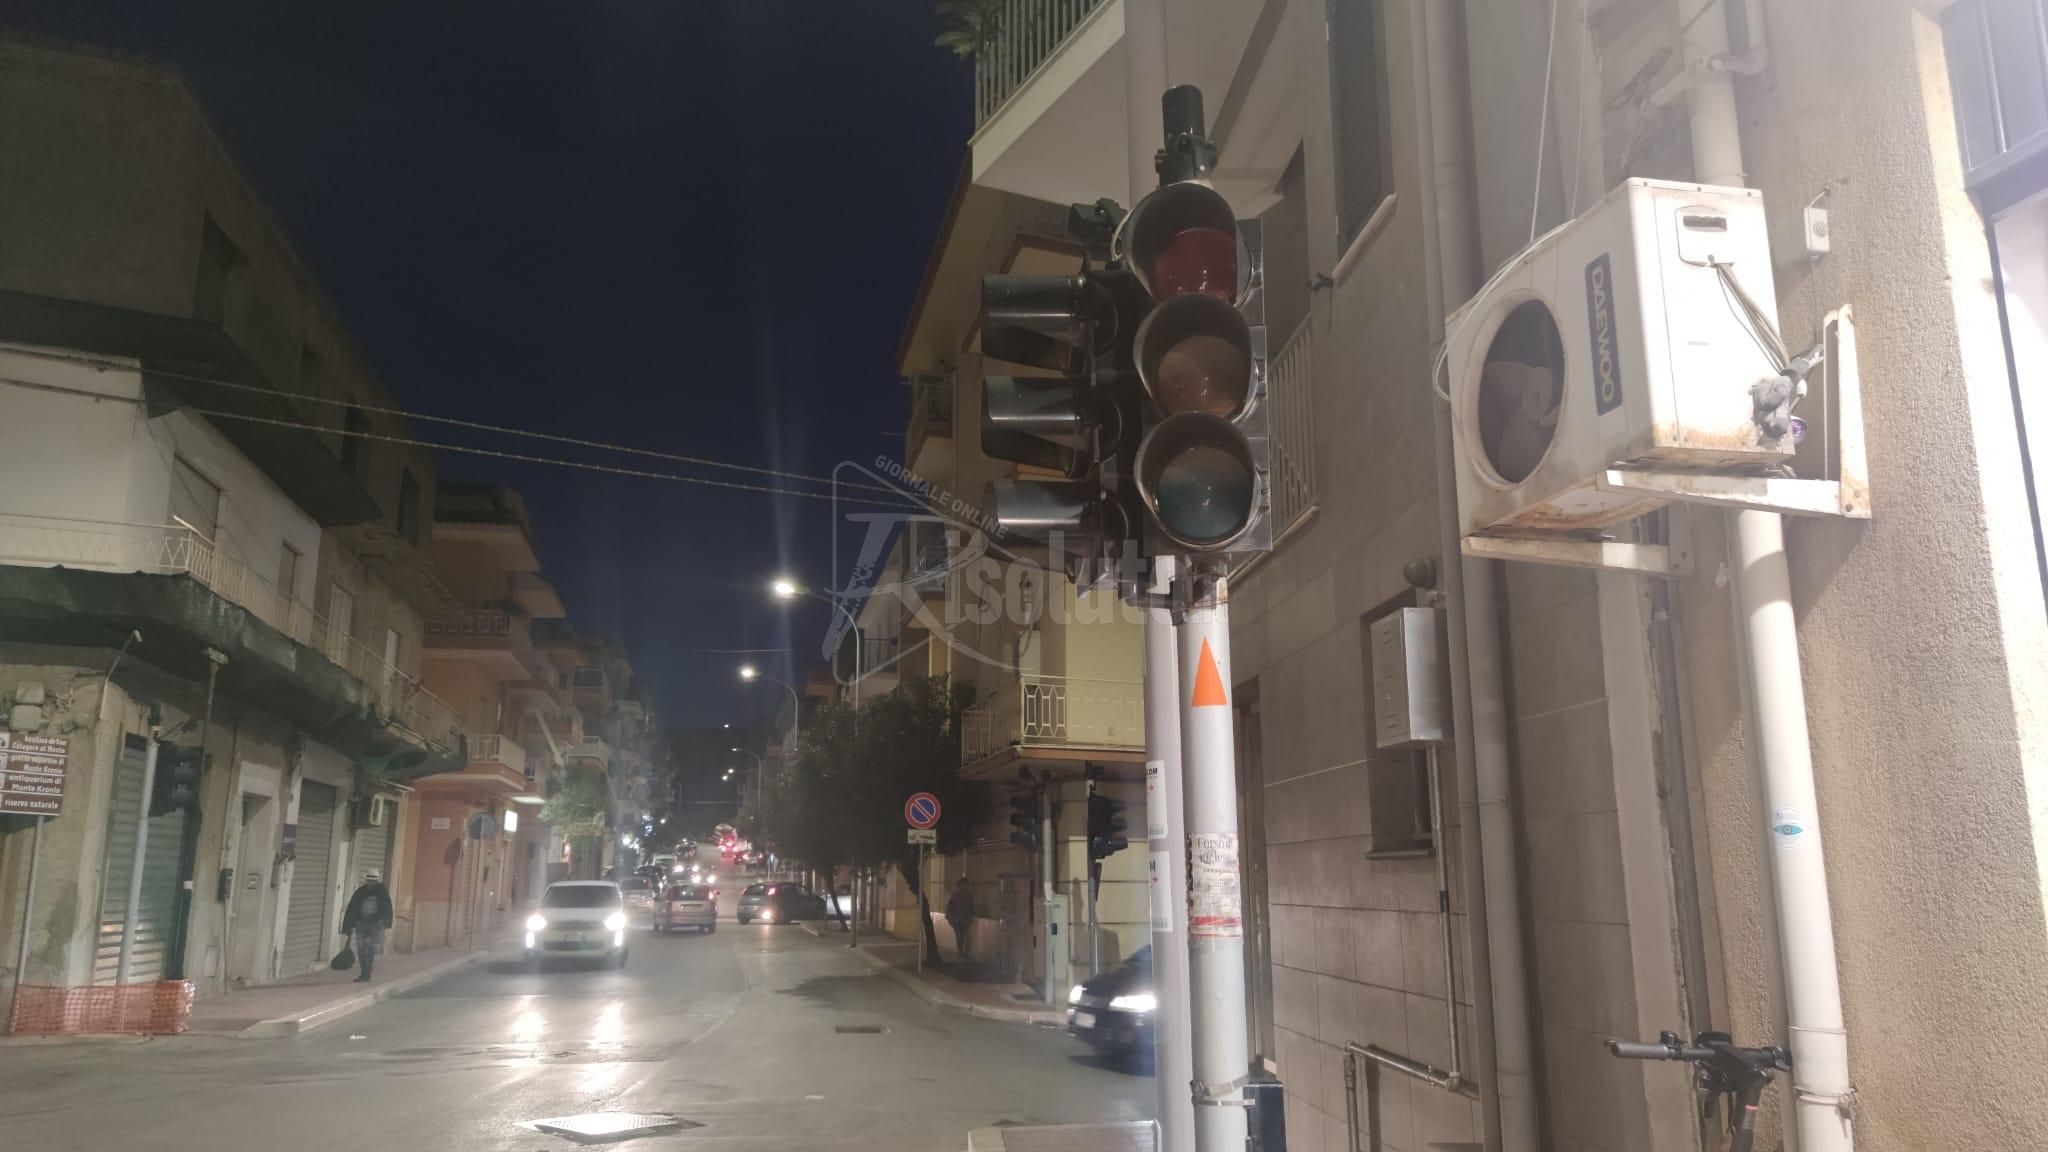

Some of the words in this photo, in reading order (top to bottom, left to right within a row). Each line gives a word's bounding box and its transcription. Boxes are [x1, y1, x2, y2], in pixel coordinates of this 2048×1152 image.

[1592, 265, 1615, 403] DAEWOO
[24, 735, 48, 745] basilica
[9, 775, 54, 784] antiquarium
[54, 777, 62, 785] di
[12, 783, 36, 792] Monte
[36, 785, 61, 794] Kronio
[5, 799, 29, 808] riserva
[30, 801, 59, 809] naturale
[1197, 837, 1225, 849] Corso
